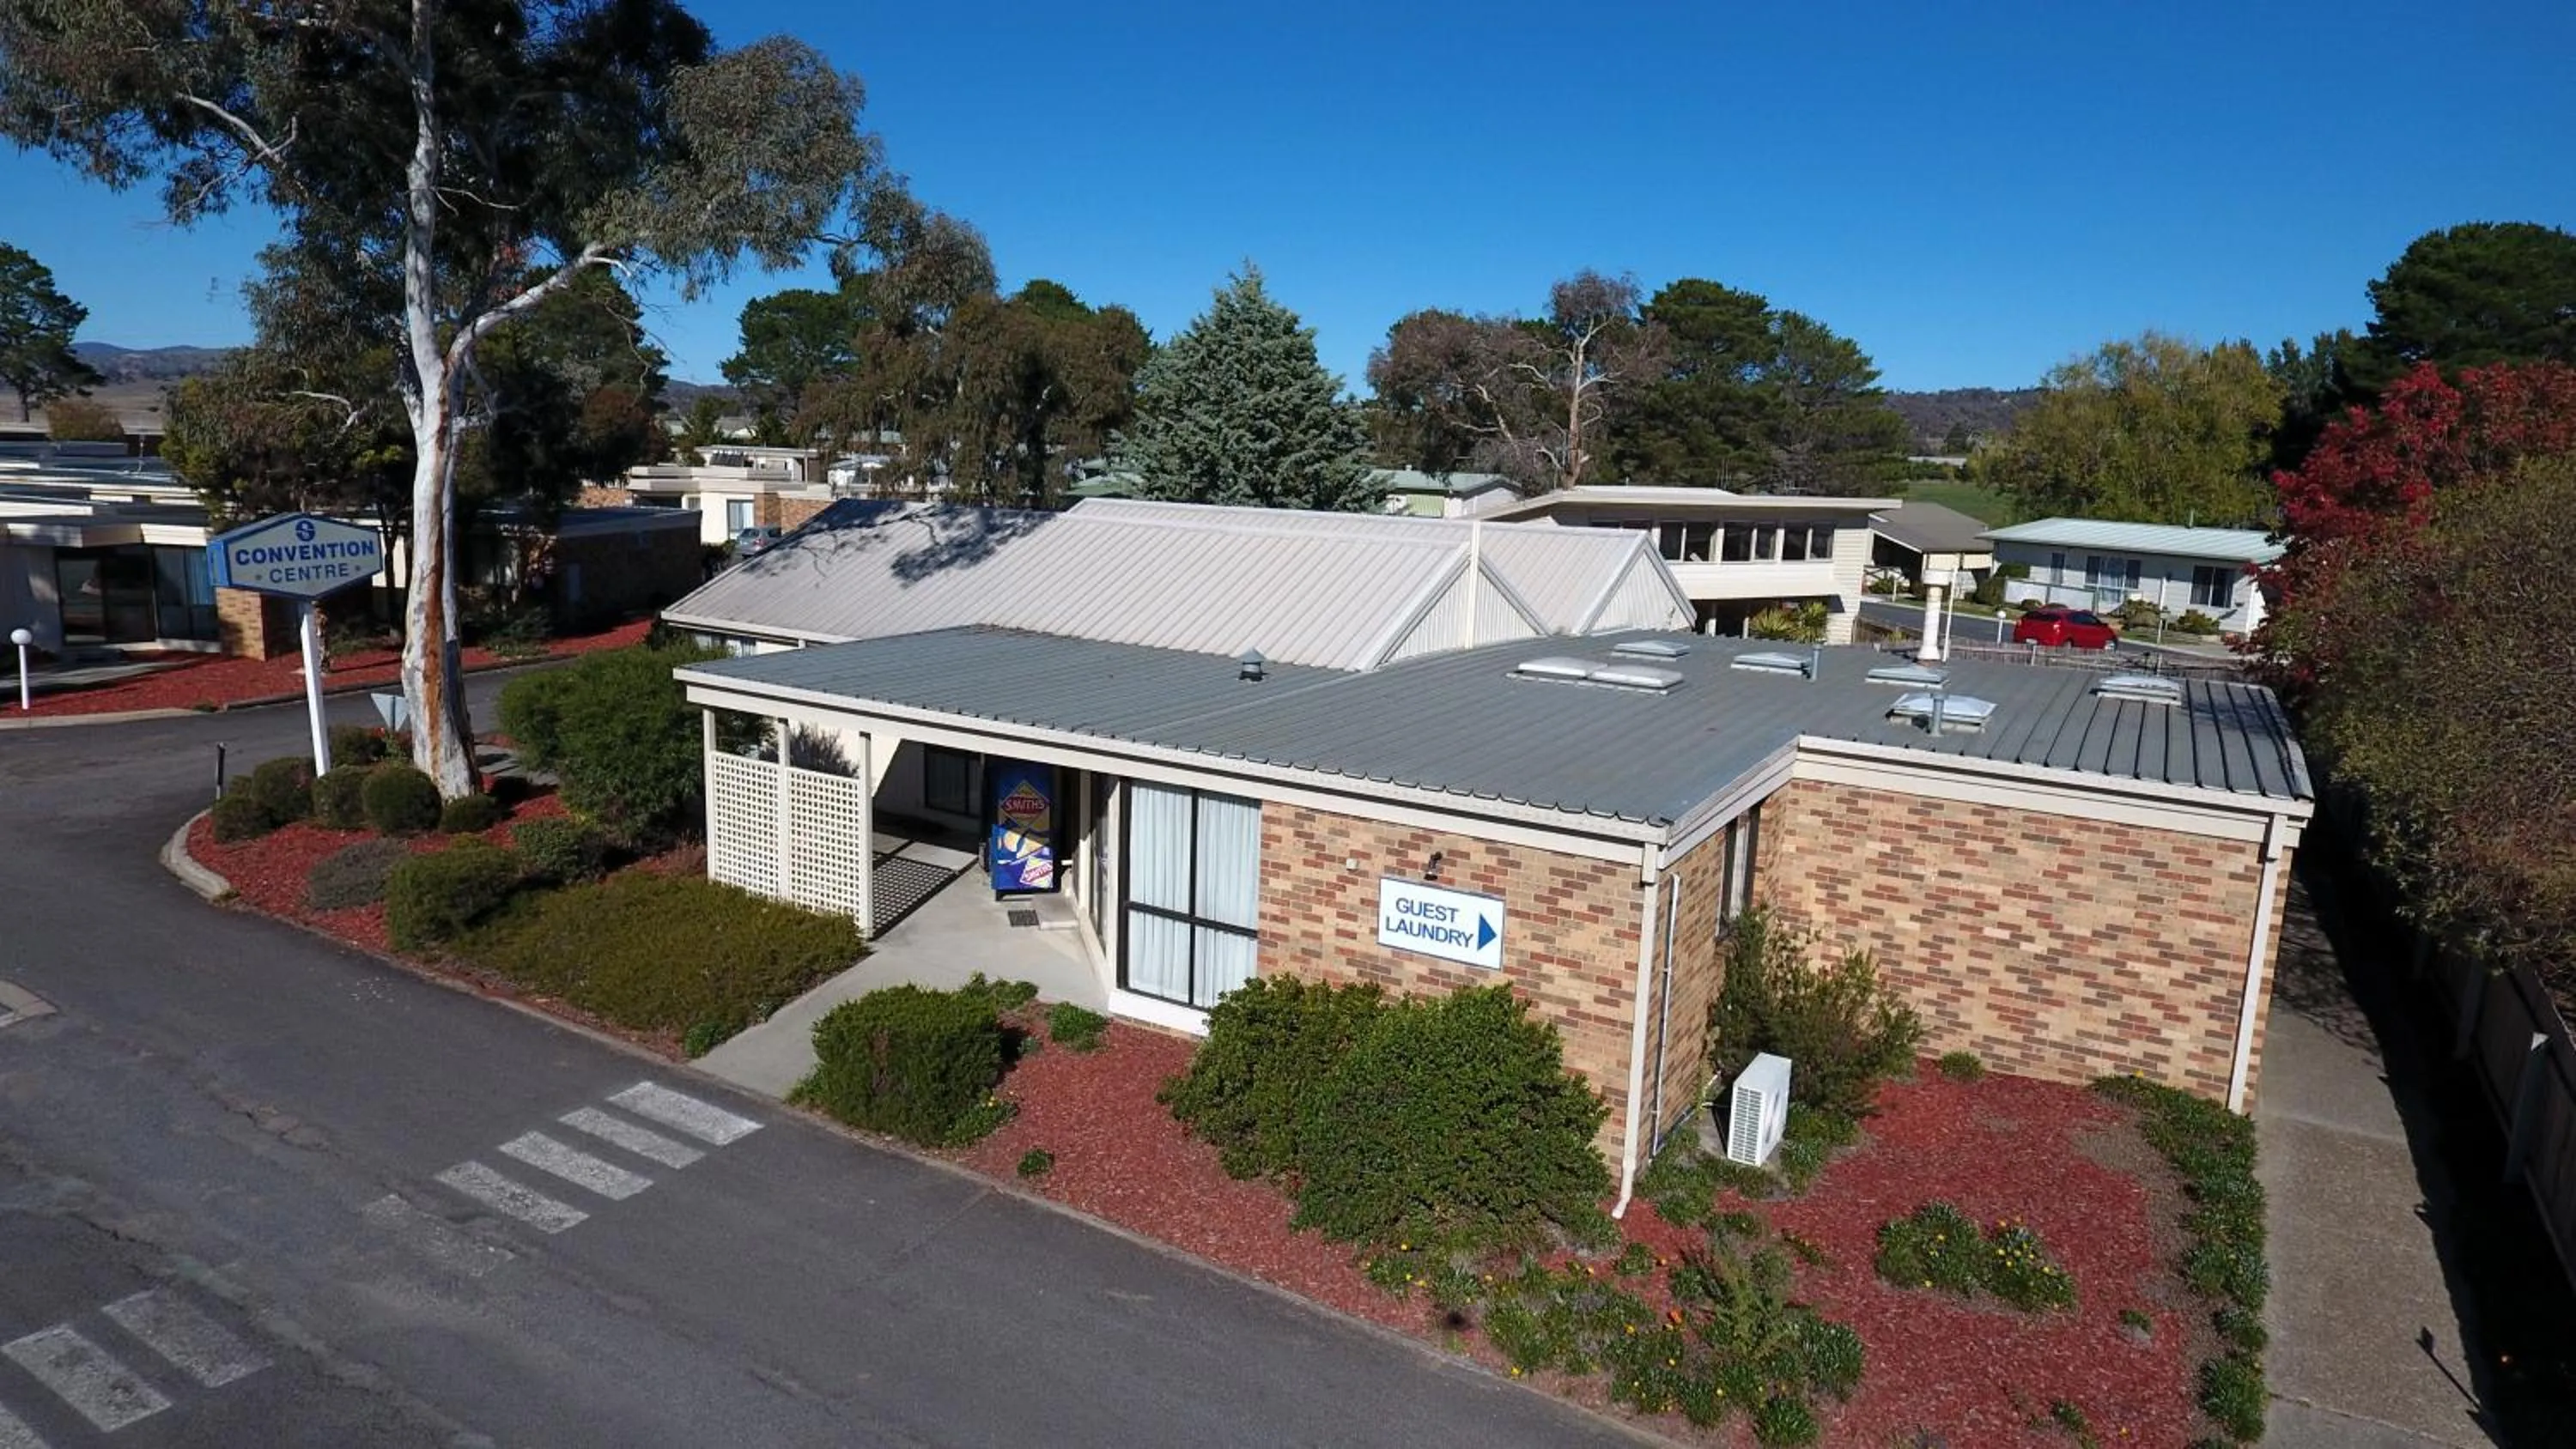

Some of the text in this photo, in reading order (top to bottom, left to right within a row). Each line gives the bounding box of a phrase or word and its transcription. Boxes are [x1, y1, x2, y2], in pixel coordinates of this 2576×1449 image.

[234, 540, 374, 566] CONVENTION
[269, 562, 349, 584] CENTRE
[1395, 897, 1459, 923] GUEST
[1385, 916, 1473, 948] LAUNDRY
